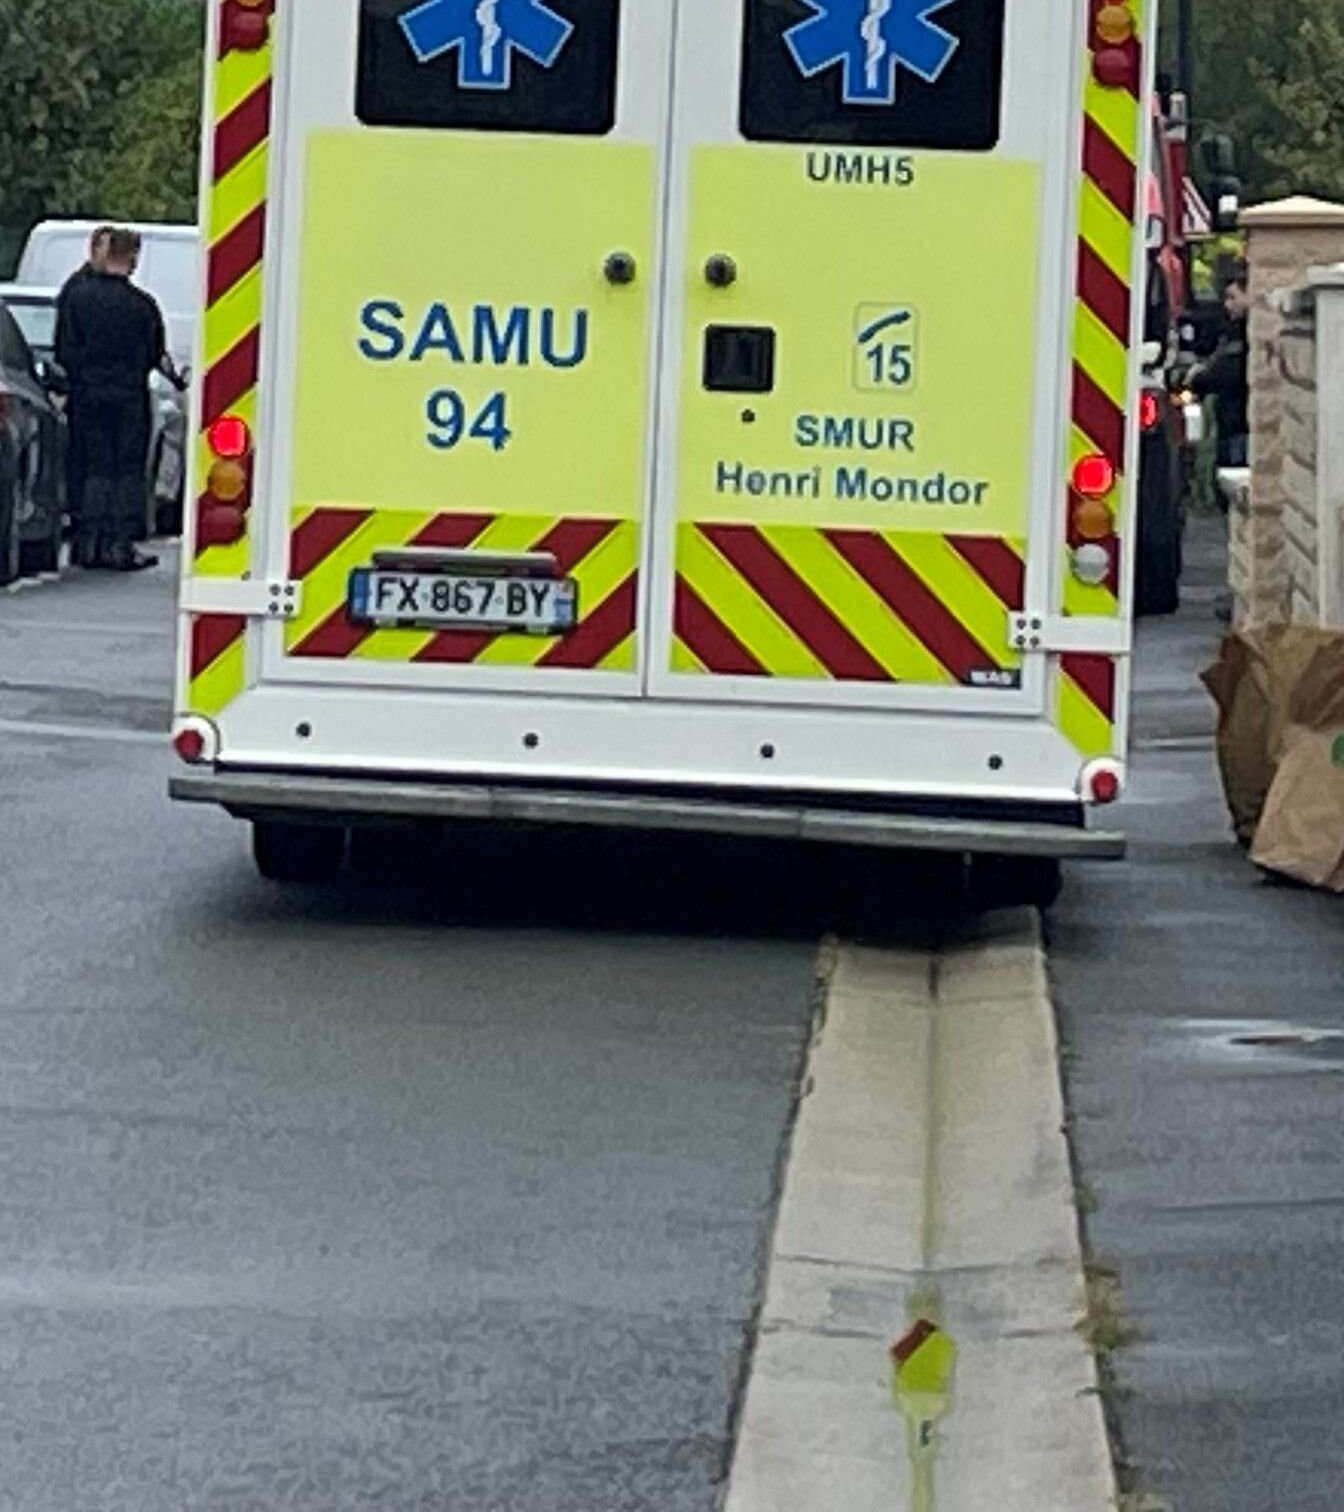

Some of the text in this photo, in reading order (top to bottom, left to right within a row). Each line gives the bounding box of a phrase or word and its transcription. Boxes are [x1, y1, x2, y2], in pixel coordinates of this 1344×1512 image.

[807, 151, 915, 186] UMH5
[358, 300, 588, 368] SAMU
[867, 342, 912, 385] 15
[426, 389, 512, 452] 94
[795, 414, 915, 451] SMUR
[716, 460, 990, 505] Henri Mondor
